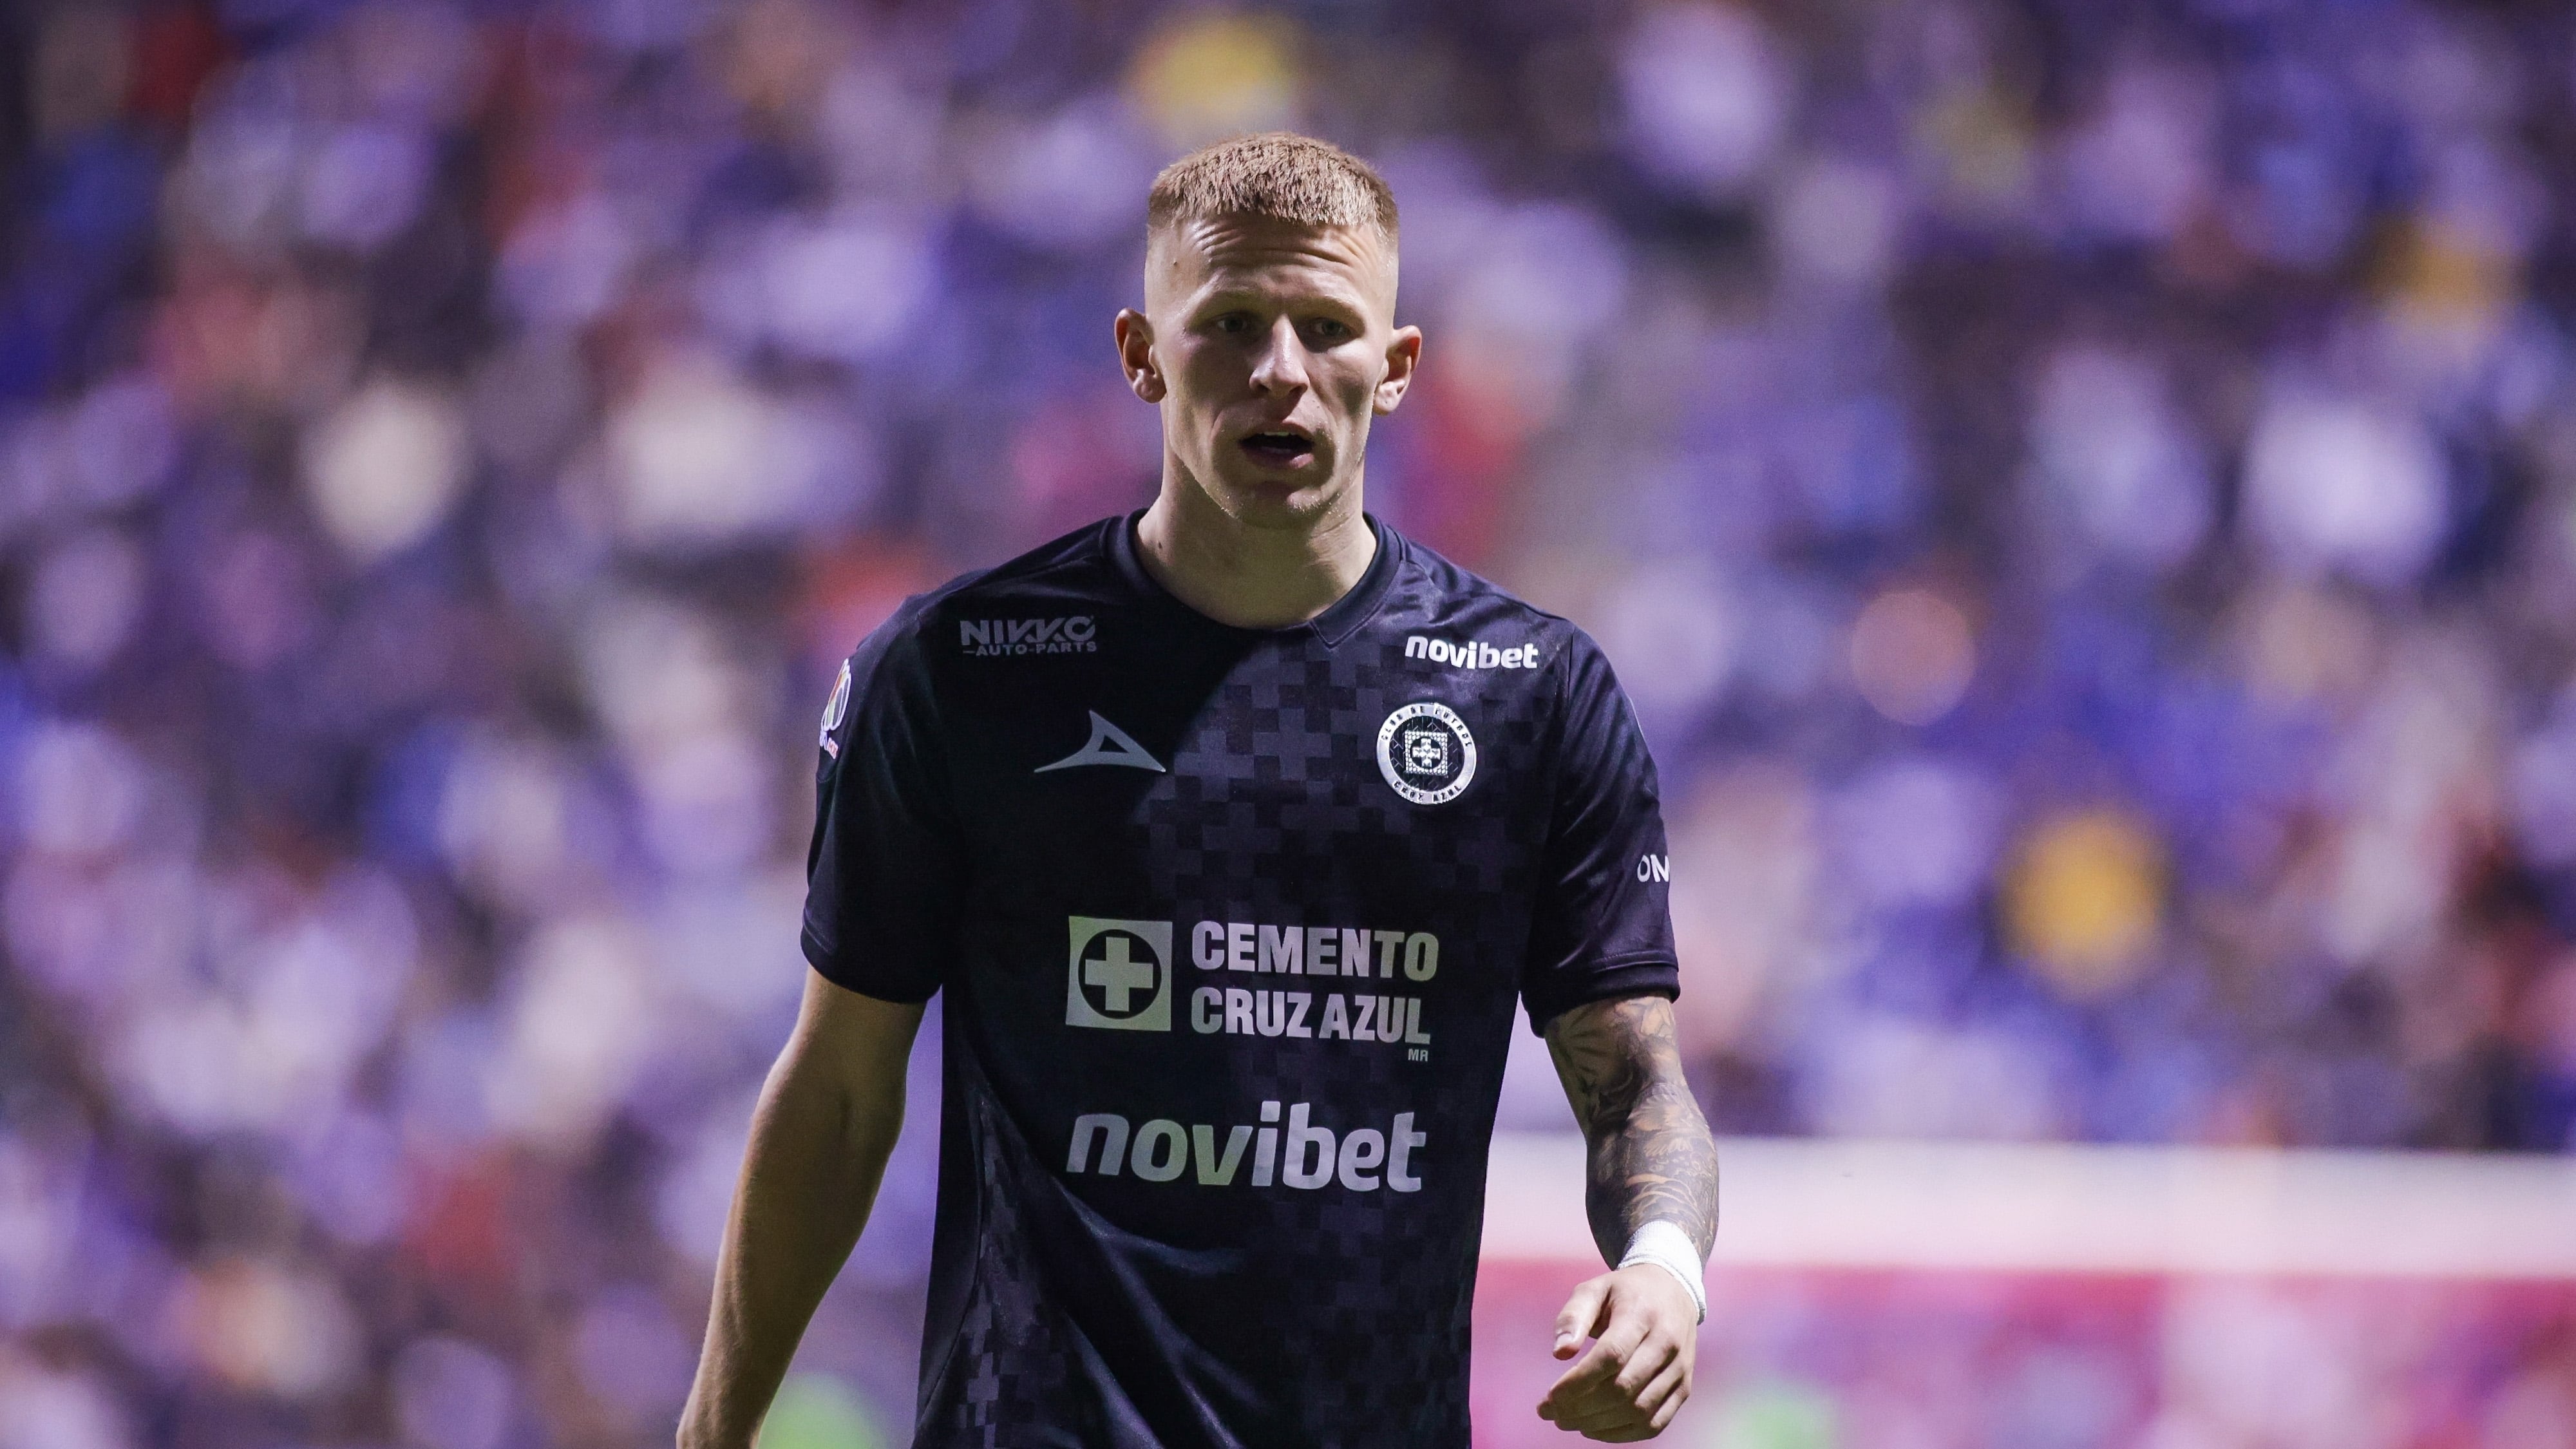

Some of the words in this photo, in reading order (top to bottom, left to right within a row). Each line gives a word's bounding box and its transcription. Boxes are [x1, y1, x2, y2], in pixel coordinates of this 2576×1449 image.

[960, 616, 1095, 645] NIKKO
[975, 641, 1097, 656] AUTO-PARTS
[1405, 636, 1539, 670] novibet
[1191, 920, 1439, 982] CEMENTO
[1191, 987, 1312, 1039] CRUZ
[1318, 993, 1430, 1045] AZUL
[1408, 1048, 1428, 1062] MR
[1066, 1101, 1426, 1193] novibet
